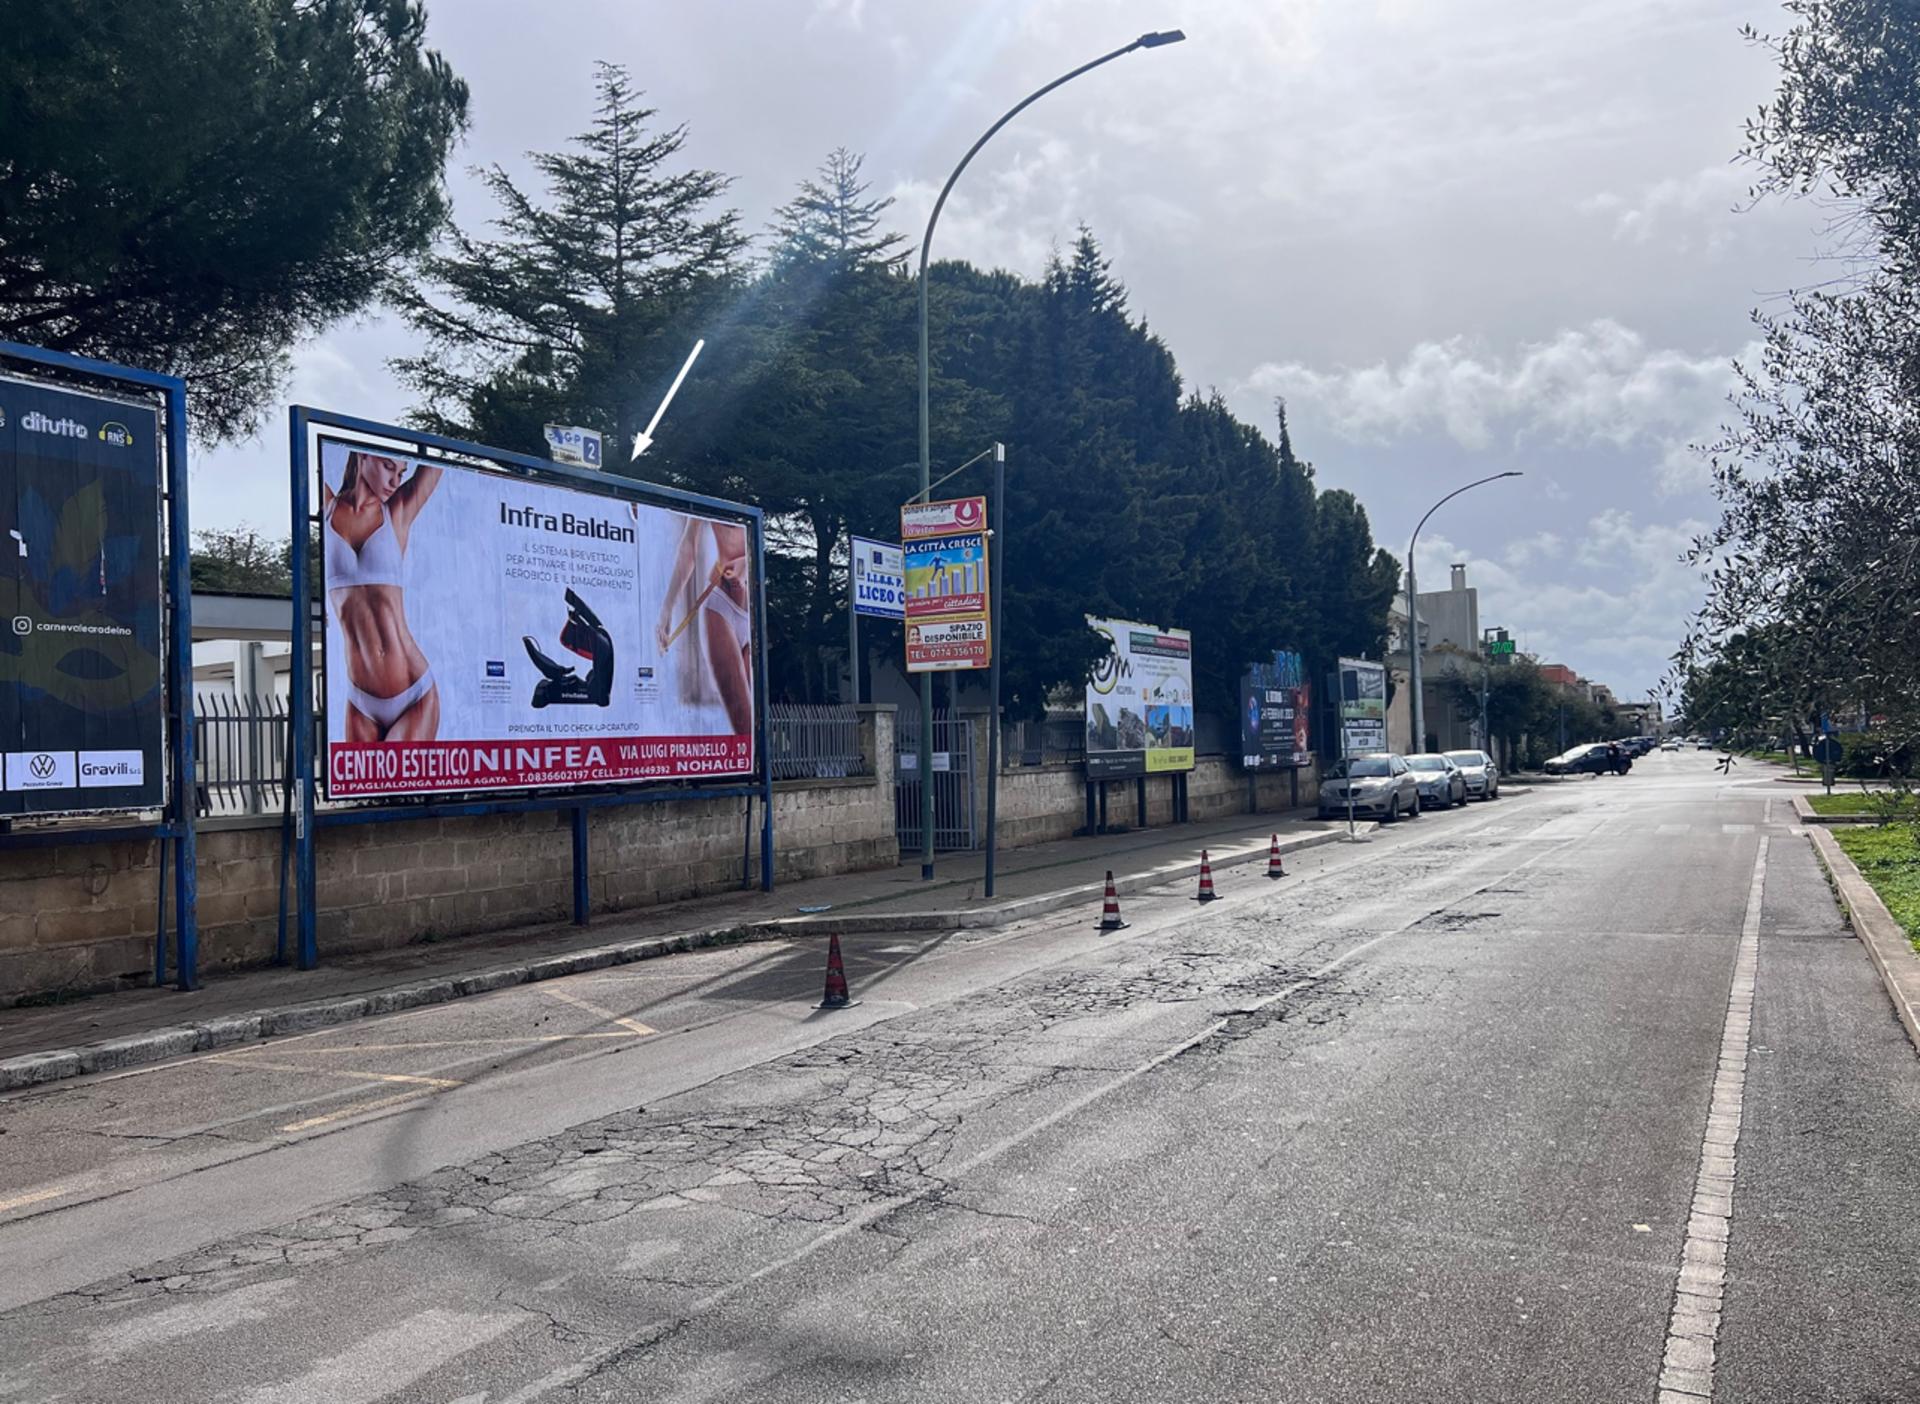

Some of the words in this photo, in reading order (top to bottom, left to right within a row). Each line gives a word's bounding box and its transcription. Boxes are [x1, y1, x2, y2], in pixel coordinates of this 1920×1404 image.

[21, 411, 88, 439] ditutto
[588, 442, 596, 460] 2
[500, 502, 558, 532] Infra
[562, 512, 635, 543] Baldan
[532, 543, 569, 557] SISTEMA
[570, 548, 620, 564] BREVETTATO
[904, 545, 917, 555] LA
[918, 540, 947, 553] CITTÀ
[947, 536, 982, 549] CRESCE
[505, 567, 552, 582] AEROBICO
[506, 553, 525, 565] PER
[527, 556, 567, 571] ATTIVARE
[576, 563, 634, 579] METABOLISMO
[858, 584, 895, 604] LICEO
[949, 622, 983, 633] SPAZIO
[924, 631, 983, 643] DISPONIBILE
[508, 724, 546, 733] PRENOTA
[554, 723, 569, 732] TUO
[619, 744, 638, 759] VIA
[641, 744, 667, 759] LUIGI
[669, 742, 728, 758] PIRANDELLO
[81, 763, 128, 775] Gravili
[333, 749, 397, 780] CENTRO
[401, 747, 469, 778] ESTETICO
[473, 745, 607, 772] NINFEA
[676, 758, 750, 772] NOHA(LE)
[332, 783, 346, 791] DI
[350, 780, 433, 791] PAGLIALONGA
[435, 777, 471, 787] MARIA
[518, 769, 589, 783] T.0836602197
